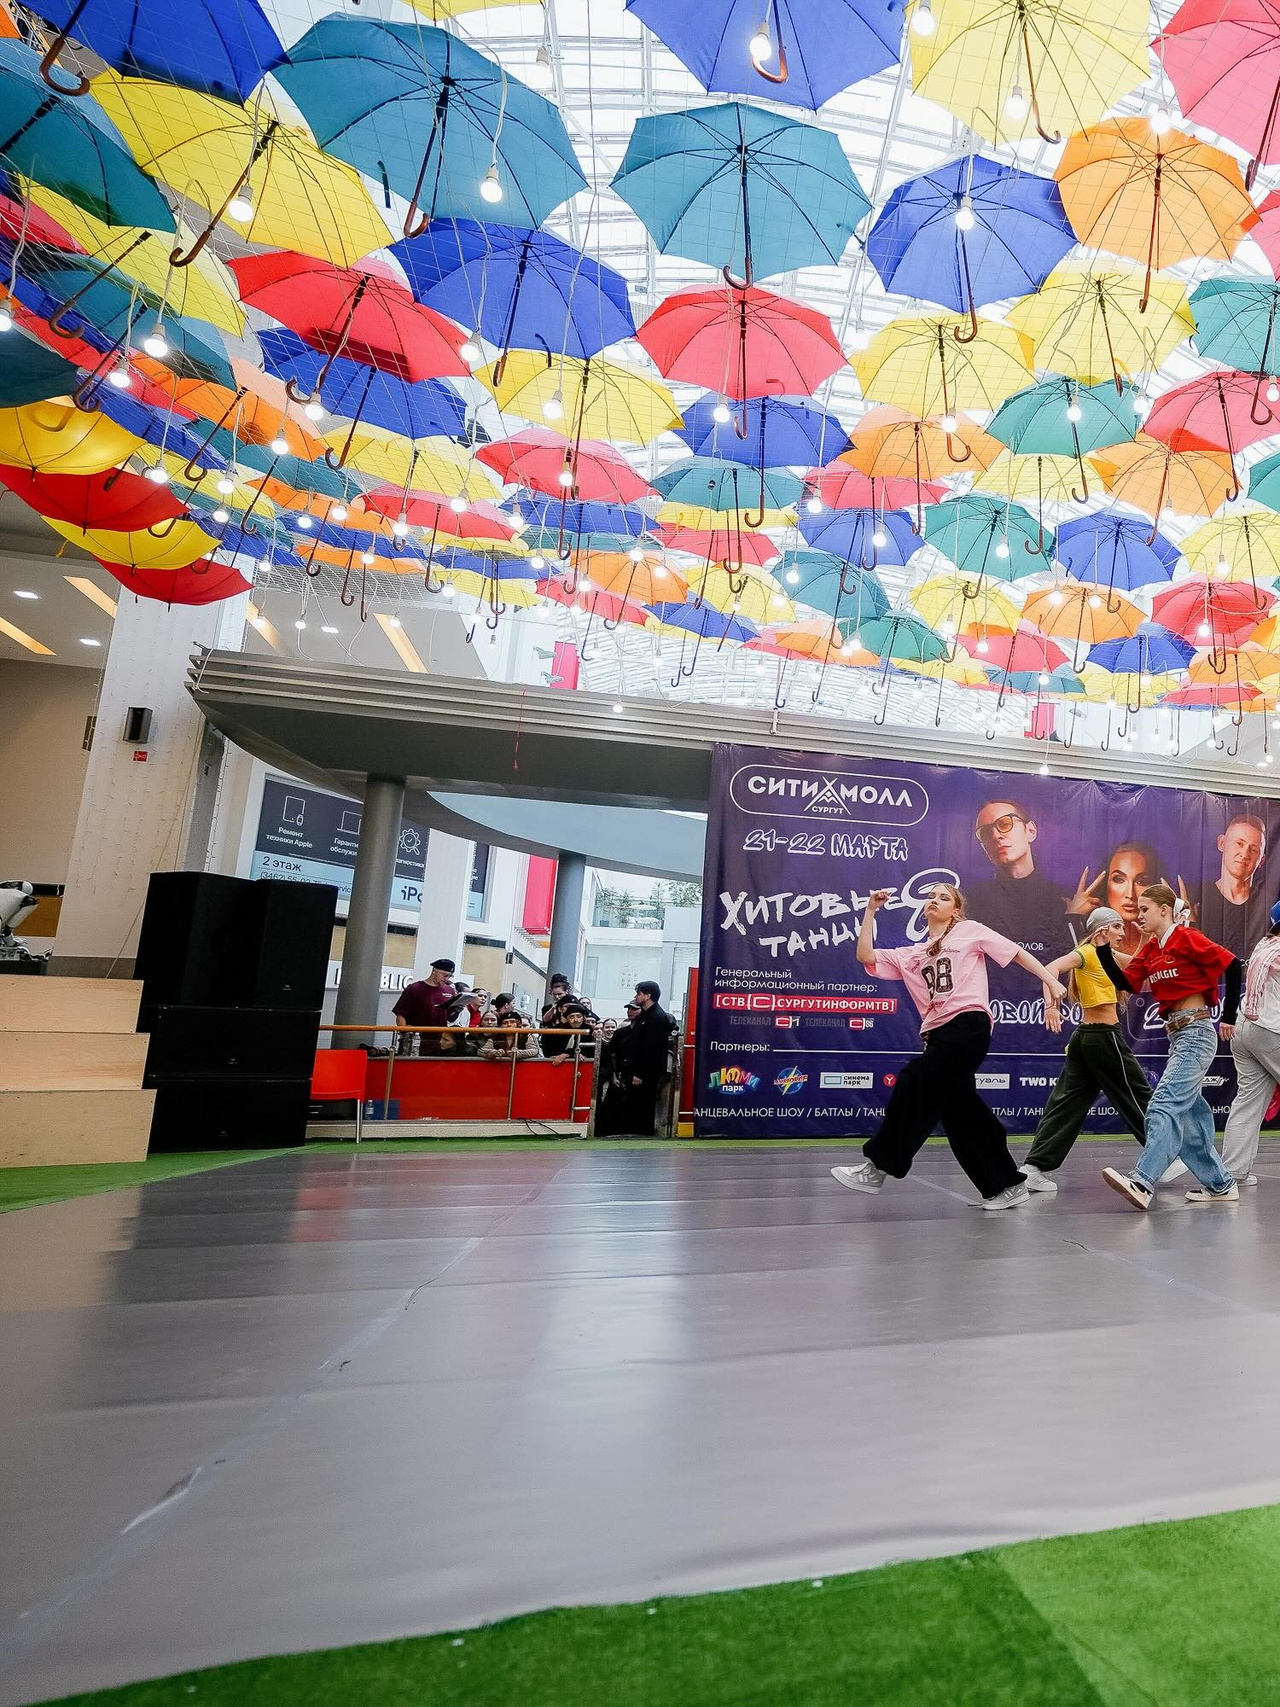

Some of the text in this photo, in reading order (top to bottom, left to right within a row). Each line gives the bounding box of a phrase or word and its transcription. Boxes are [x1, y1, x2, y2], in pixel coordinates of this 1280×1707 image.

[812, 805, 844, 815] СУРГУТ
[278, 826, 304, 838] Ремонт
[266, 834, 313, 849] техники Apple
[333, 838, 359, 848] Гаранти
[743, 829, 909, 861] 21-22 МАРТА
[330, 846, 358, 857] обслужи
[262, 856, 302, 872] 2 этаж
[395, 858, 425, 868] агностика
[1015, 941, 1044, 951] ОЛОВ
[715, 966, 793, 979] Генеральный
[714, 979, 879, 993] информационный партнер:
[729, 1016, 772, 1026] ТЕЛЕКАНАЛ
[805, 1017, 846, 1028] ТЕЛЕКАНАЛ
[710, 1041, 771, 1053] Партнеры:
[1020, 1077, 1047, 1087] TWO
[722, 1084, 744, 1094] парк
[694, 1107, 774, 1117] АНЦЕВАЛЬНОЕ
[777, 1108, 805, 1117] ШОУ
